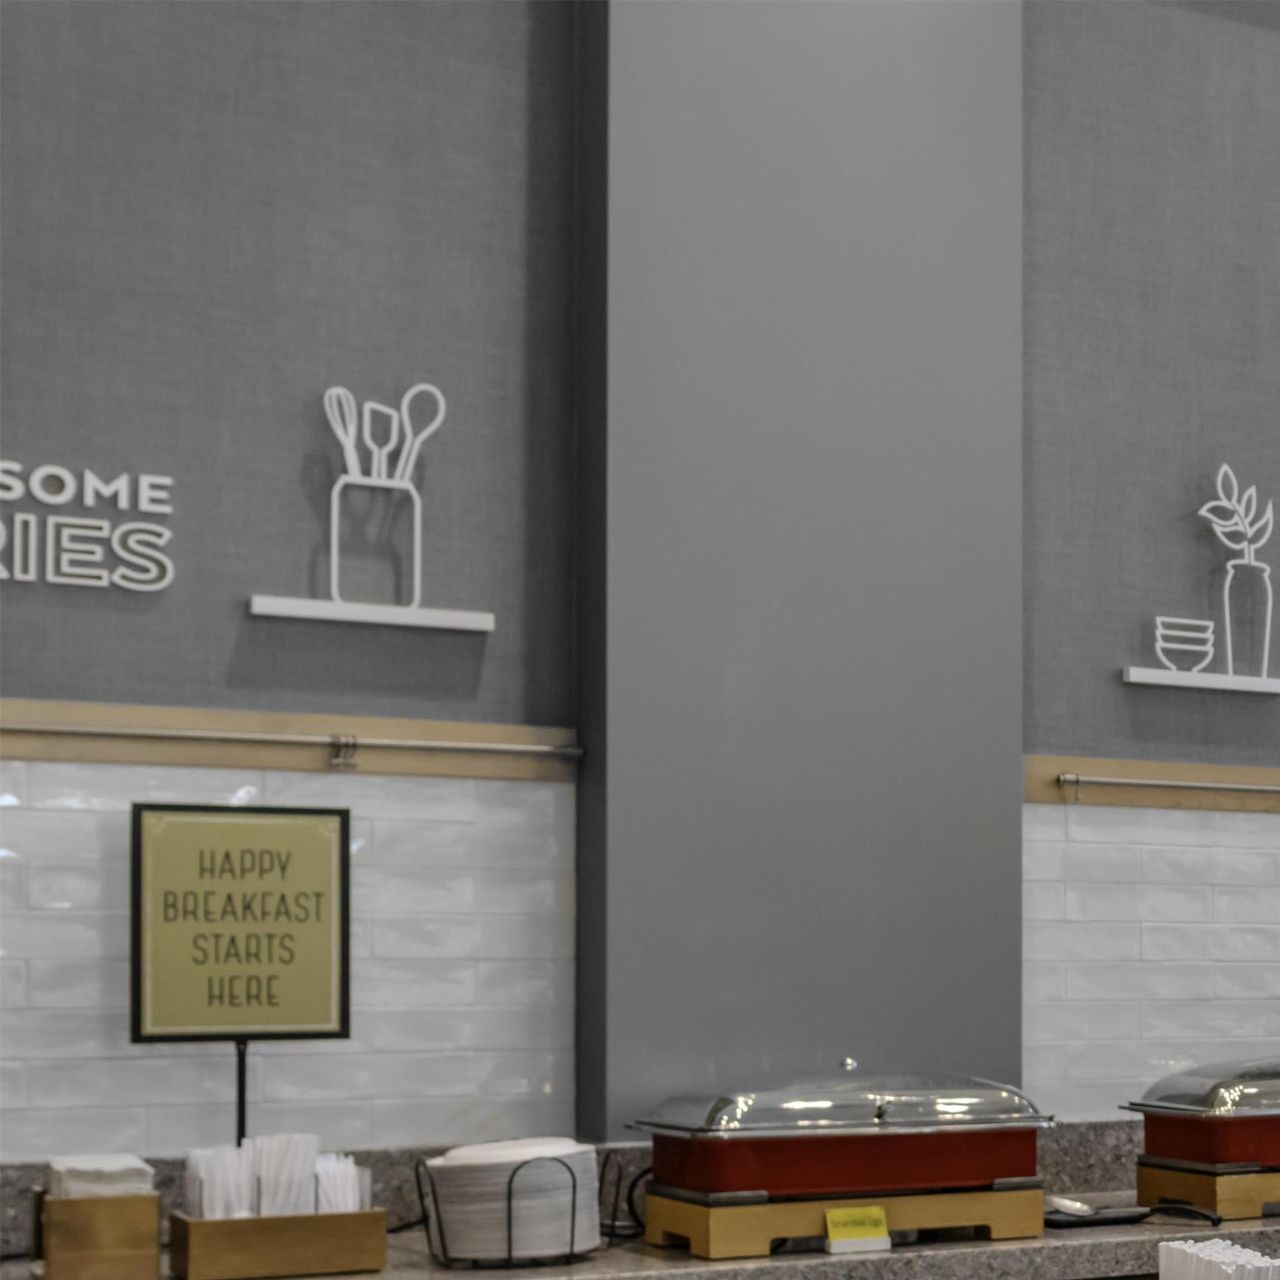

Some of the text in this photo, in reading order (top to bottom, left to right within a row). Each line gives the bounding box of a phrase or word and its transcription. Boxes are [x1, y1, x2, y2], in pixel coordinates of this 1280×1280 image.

[0, 512, 176, 592] IES
[199, 849, 292, 881] HAPPY
[163, 890, 325, 924] BREAKFAST
[192, 932, 296, 966] STARTS
[207, 975, 280, 1007] HERE
